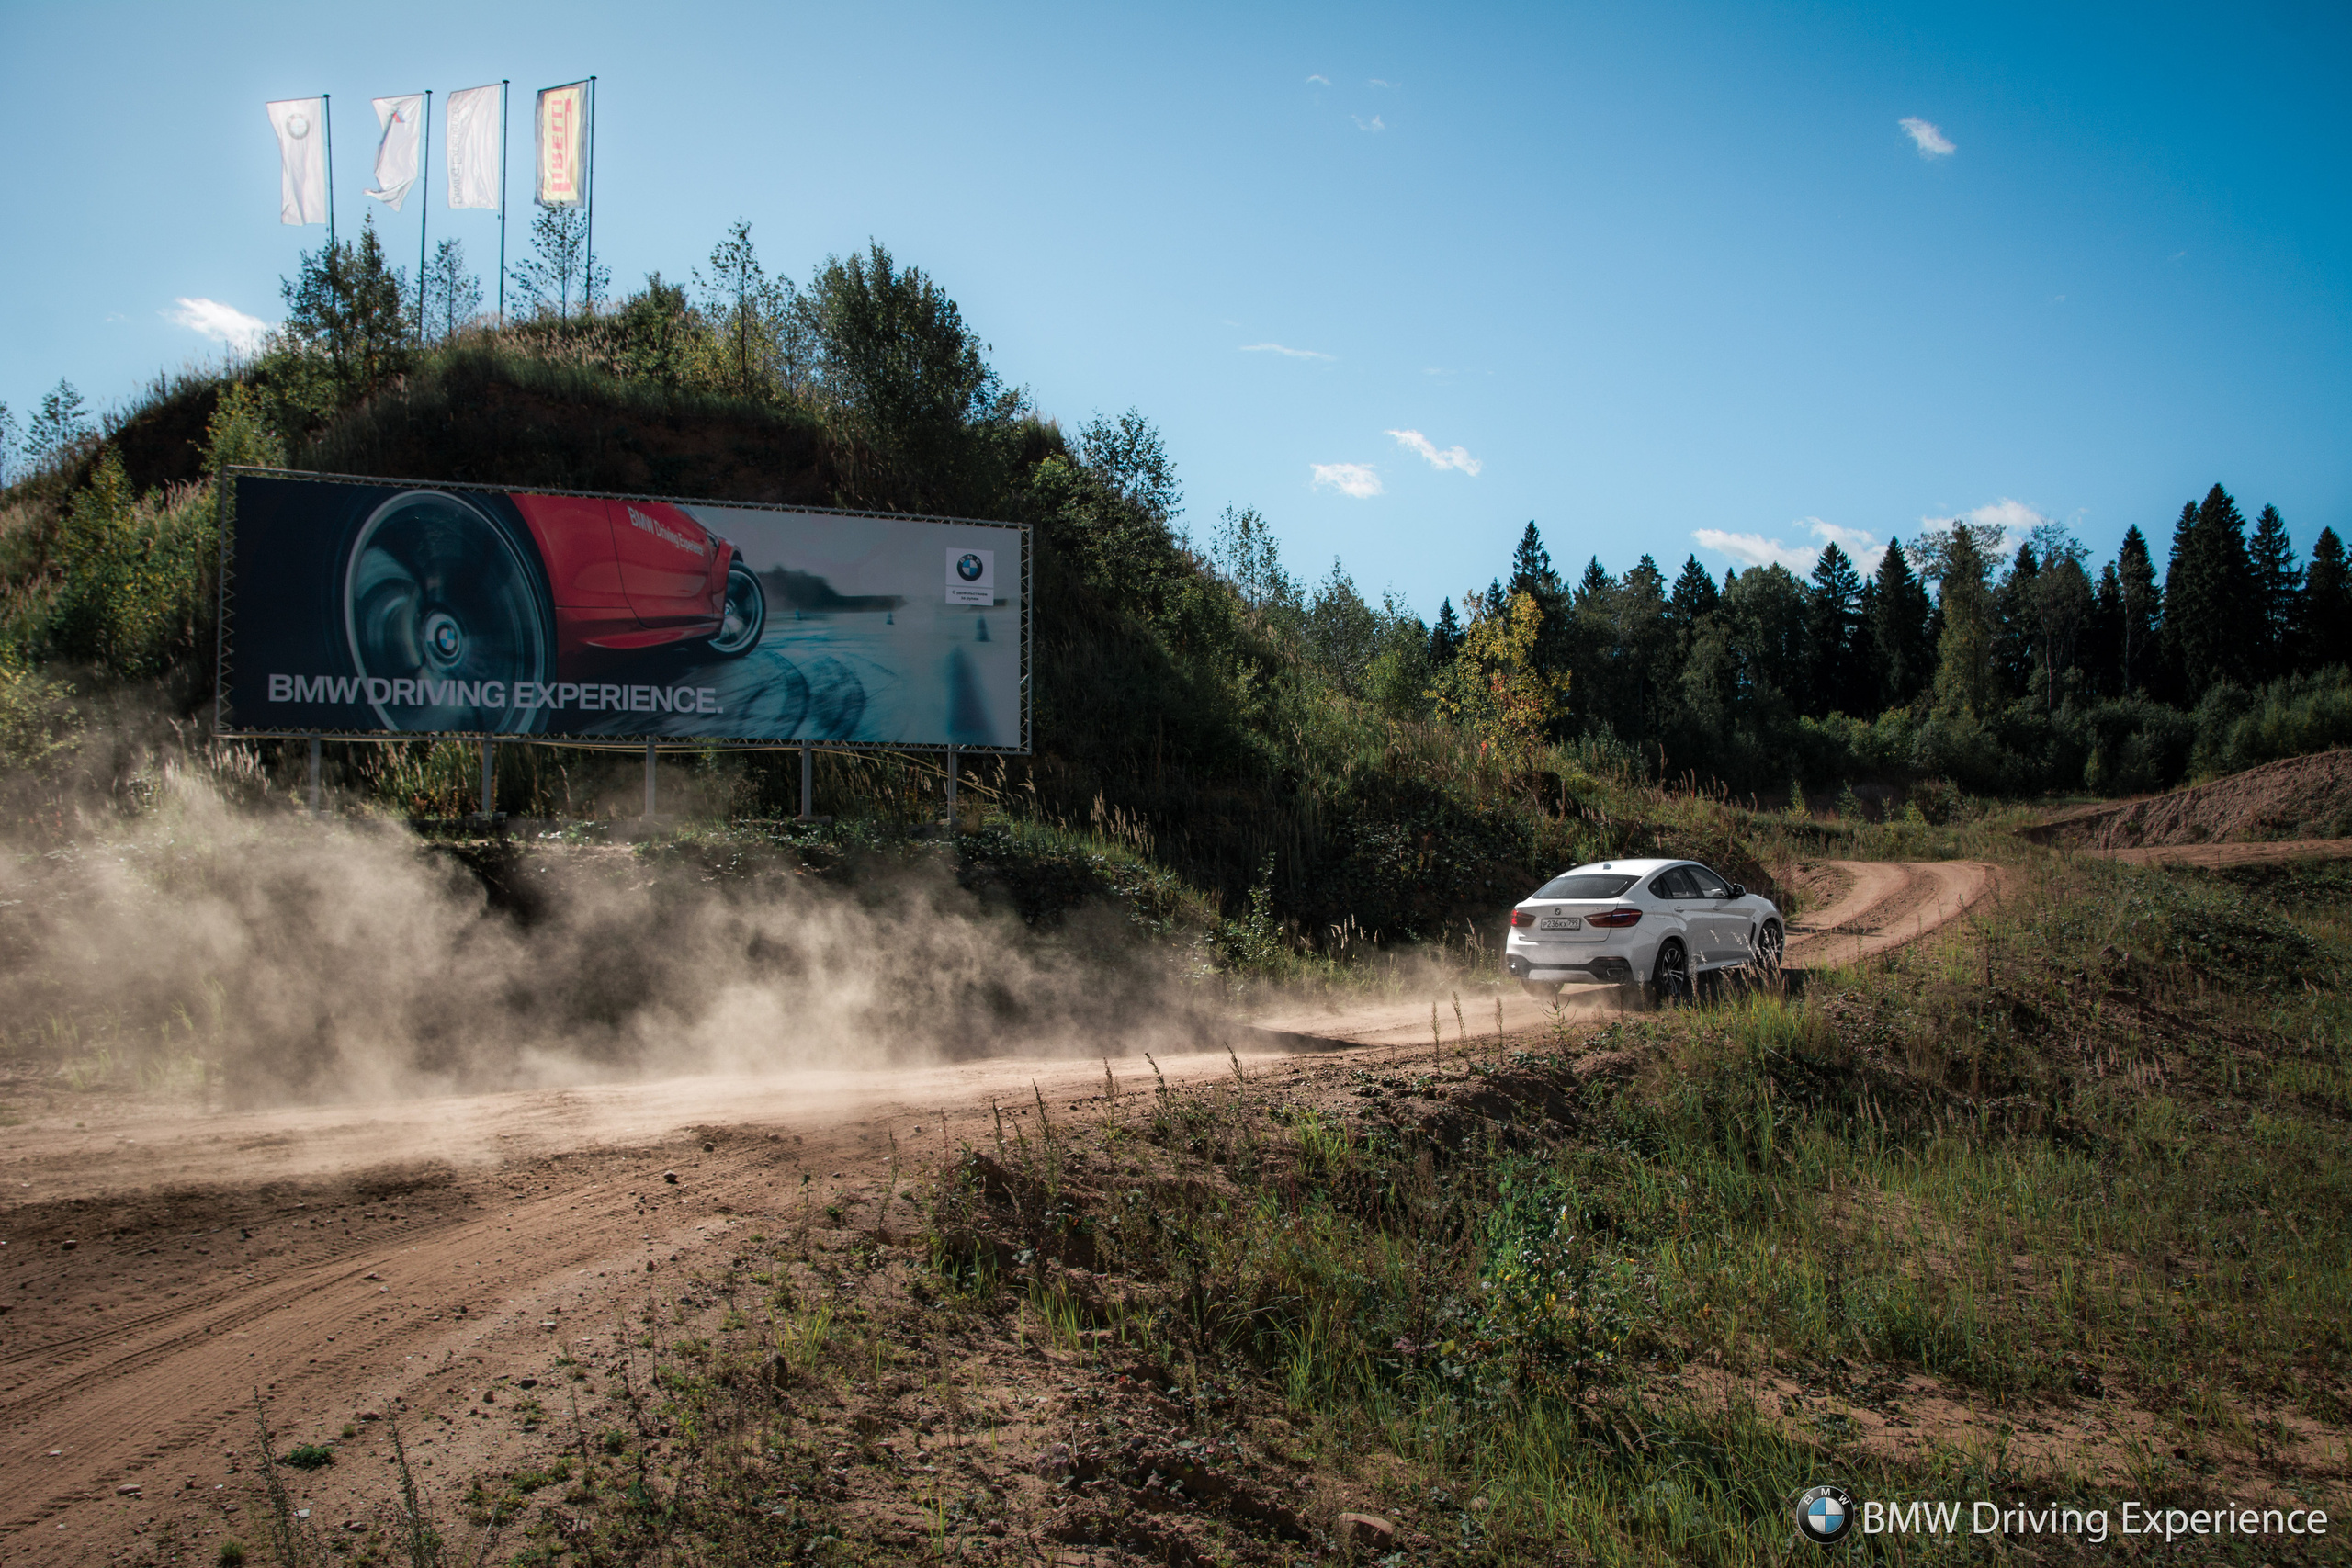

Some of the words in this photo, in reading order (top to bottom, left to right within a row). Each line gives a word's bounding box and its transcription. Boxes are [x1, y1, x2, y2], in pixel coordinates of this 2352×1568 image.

[627, 505, 654, 535] BMW
[653, 519, 680, 549] Driving
[959, 554, 980, 564] BMW
[267, 672, 364, 705] BMW
[365, 677, 507, 710] DRIVING
[513, 682, 725, 715] EXPERIENCE.
